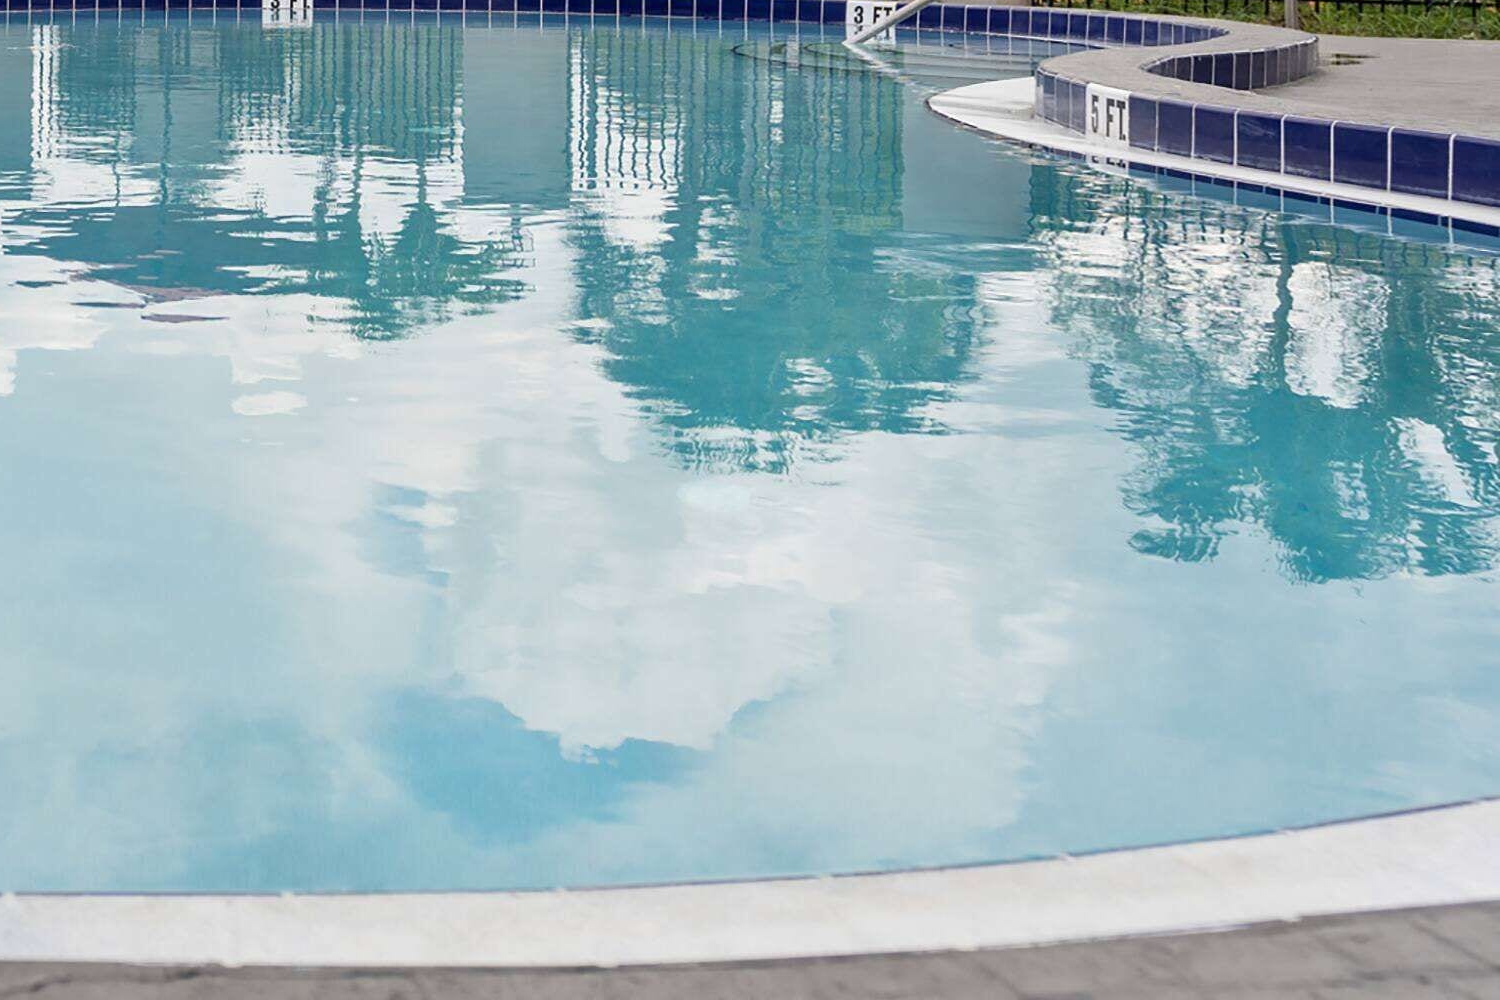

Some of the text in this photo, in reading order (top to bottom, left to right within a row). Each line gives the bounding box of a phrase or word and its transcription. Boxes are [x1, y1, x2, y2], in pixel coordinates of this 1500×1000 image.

[854, 6, 864, 24] 3
[1091, 94, 1126, 141] 5 FT.
